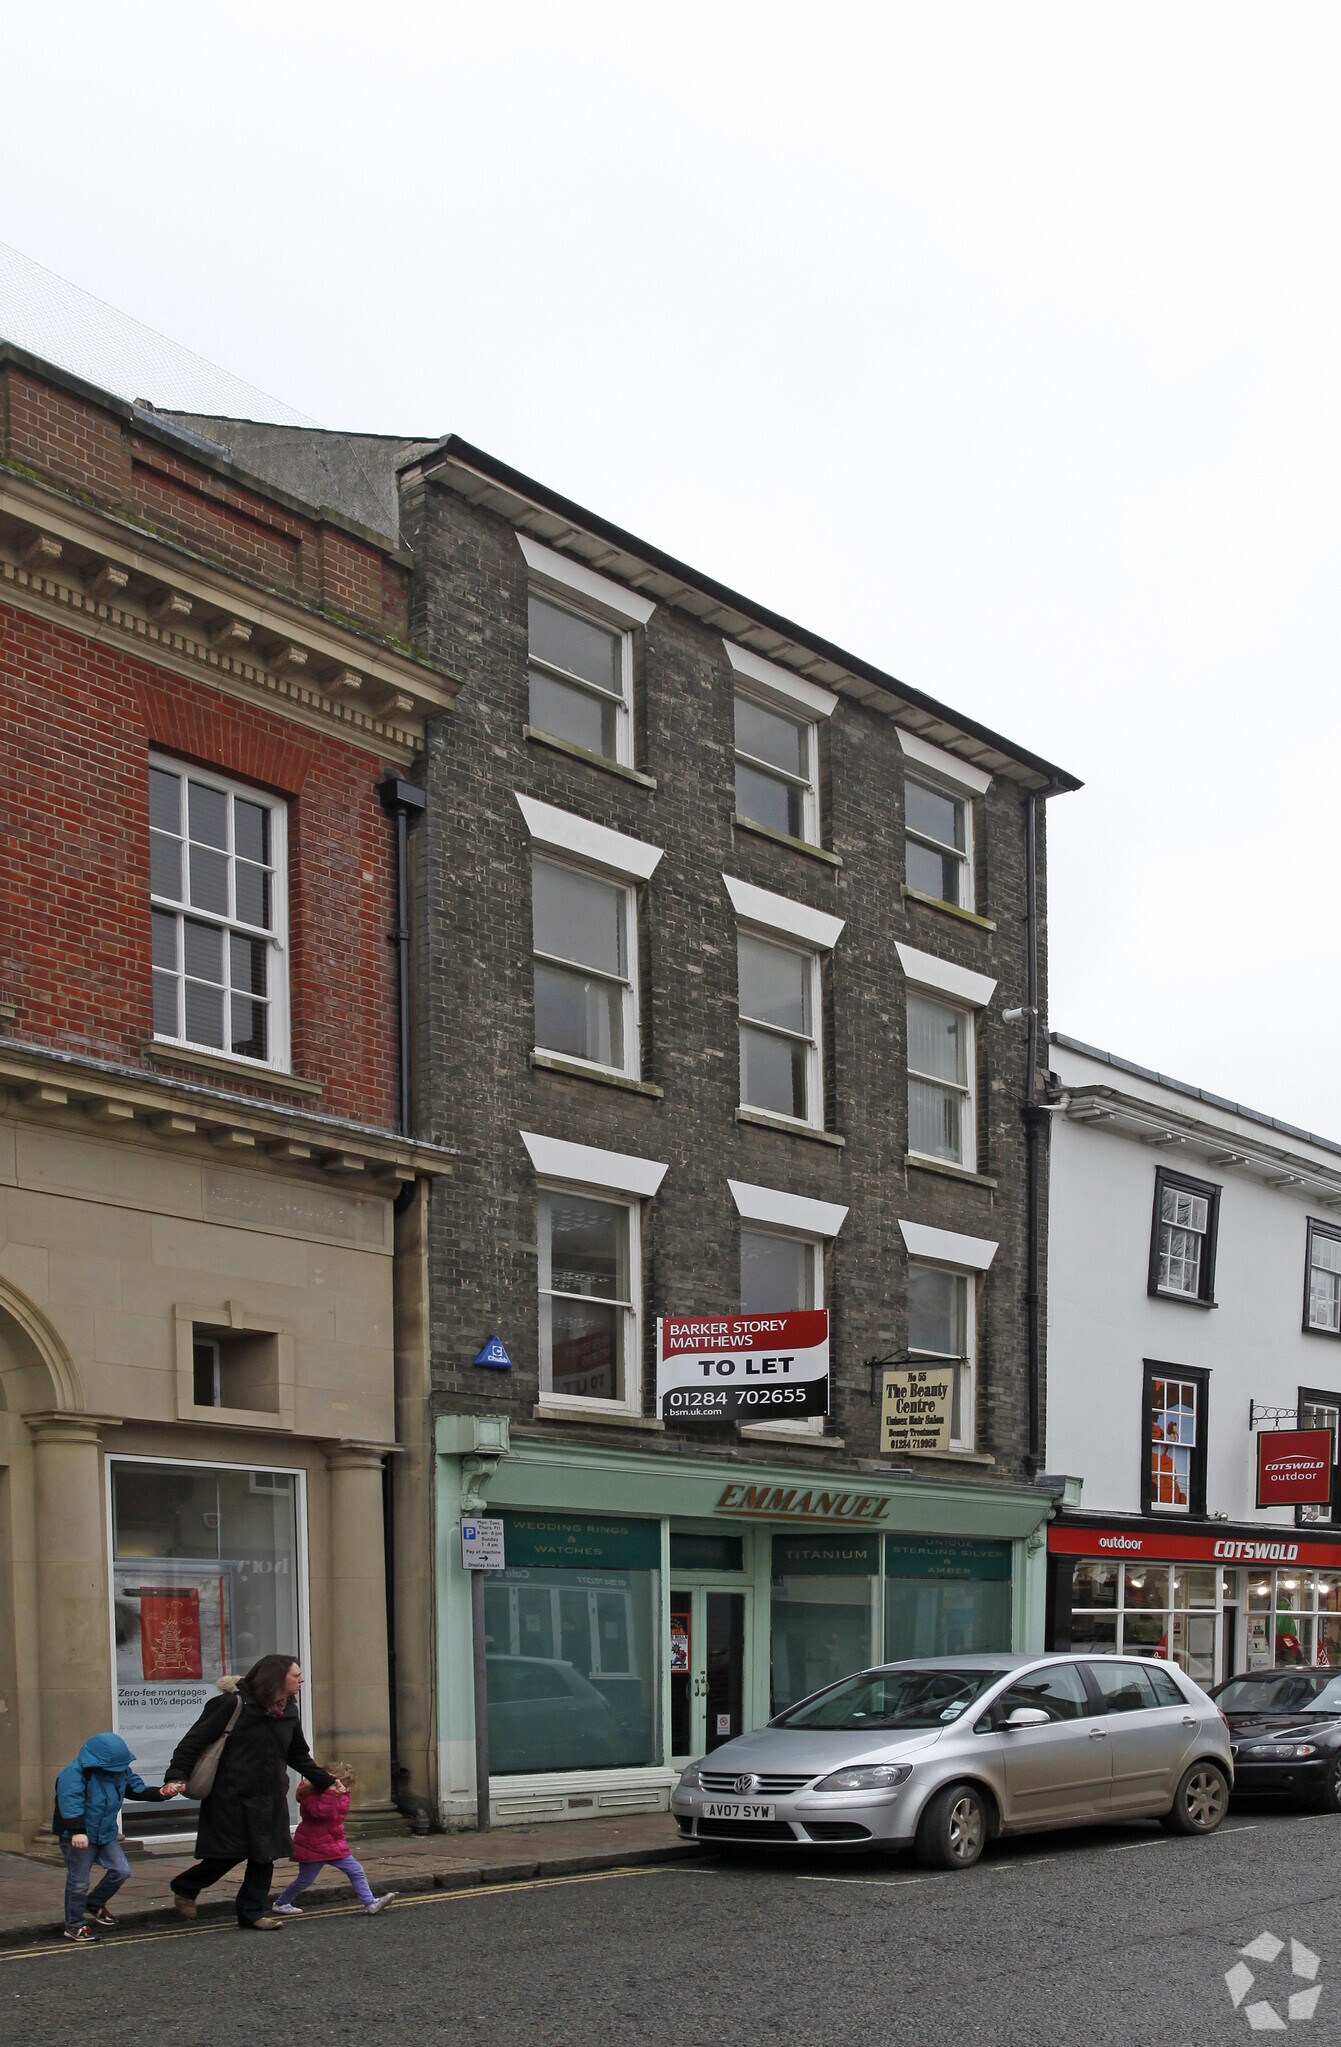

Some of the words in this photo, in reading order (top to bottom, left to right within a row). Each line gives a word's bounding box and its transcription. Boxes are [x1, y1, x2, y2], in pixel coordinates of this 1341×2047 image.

[670, 1323, 729, 1336] BARKER
[733, 1319, 788, 1334] STOREY
[670, 1334, 754, 1349] MATTHEWS
[698, 1360, 736, 1377] TO
[745, 1356, 795, 1375] LET
[918, 1372, 927, 1382] 55
[669, 1391, 728, 1407] 01284
[734, 1388, 807, 1405] 702655
[886, 1383, 907, 1399] The
[909, 1382, 949, 1401] Beauty
[895, 1398, 936, 1414] Centre
[669, 1408, 722, 1417] bsm.uk.com
[886, 1416, 908, 1426] Unisex
[908, 1415, 924, 1425] Hair
[925, 1414, 944, 1425] Salon
[888, 1428, 909, 1439] Beauty
[910, 1428, 941, 1437] Treatment
[890, 1439, 911, 1449] 01284
[1264, 1460, 1325, 1472] COTSWOLD
[1270, 1471, 1318, 1482] outdoor
[716, 1484, 892, 1519] EMMANUEL
[466, 1528, 475, 1539] P
[513, 1520, 583, 1533] WEDDING
[586, 1524, 629, 1535] RINGS
[567, 1535, 577, 1543] &
[925, 1538, 974, 1548] UNIQUE
[1098, 1535, 1143, 1550] outdoor
[534, 1545, 603, 1556] WATCHES
[786, 1549, 868, 1560] TITANIUM
[893, 1546, 958, 1556] STERLING
[960, 1549, 1003, 1558] SILVER
[1213, 1540, 1299, 1561] COTSWOLD
[927, 1566, 972, 1575] AMBER
[118, 1688, 157, 1698] Zero-fee
[158, 1688, 207, 1698] mortgages
[118, 1698, 139, 1706] with
[149, 1697, 168, 1706] 10%
[169, 1697, 203, 1707] deposit
[708, 1803, 739, 1817] AV07
[743, 1804, 771, 1818] SYW
